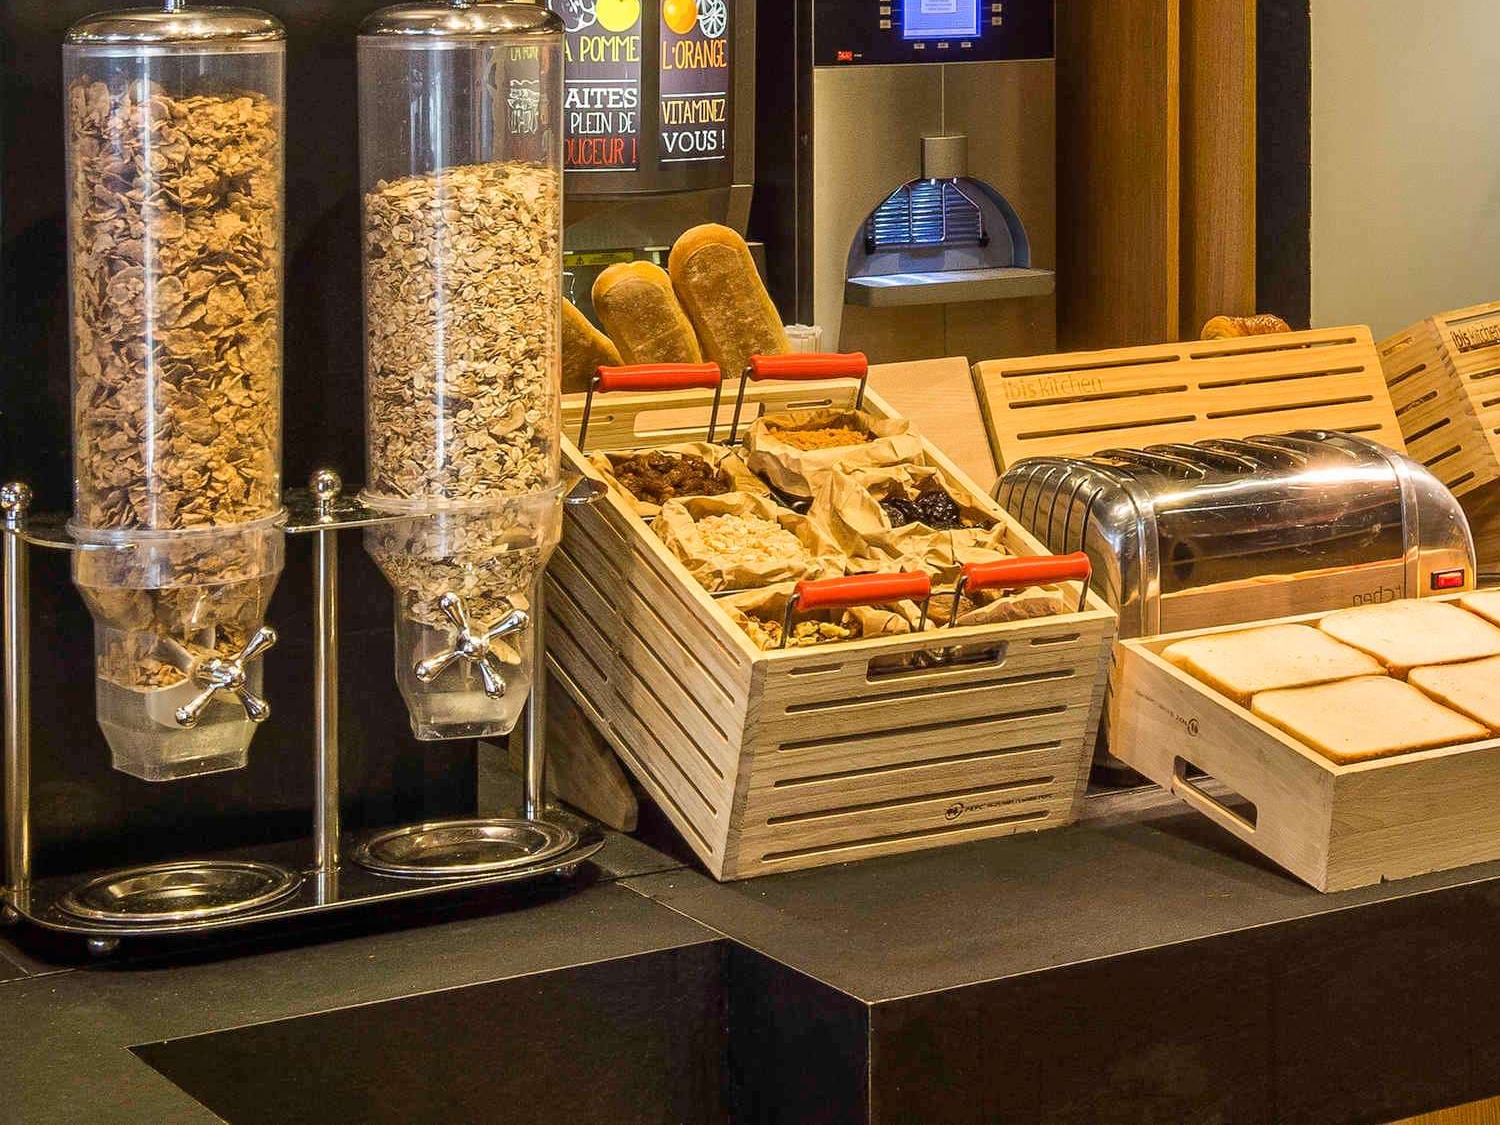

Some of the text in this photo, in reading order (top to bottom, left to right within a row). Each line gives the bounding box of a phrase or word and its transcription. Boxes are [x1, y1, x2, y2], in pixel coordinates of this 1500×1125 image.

[580, 36, 640, 63] POMME
[662, 40, 727, 69] L'ORANGE
[564, 87, 637, 108] AITES
[570, 112, 636, 134] PLEIN DE
[661, 99, 726, 124] VITAMINEZ
[564, 138, 625, 165] UCEUR
[1038, 375, 1104, 396] kitchen
